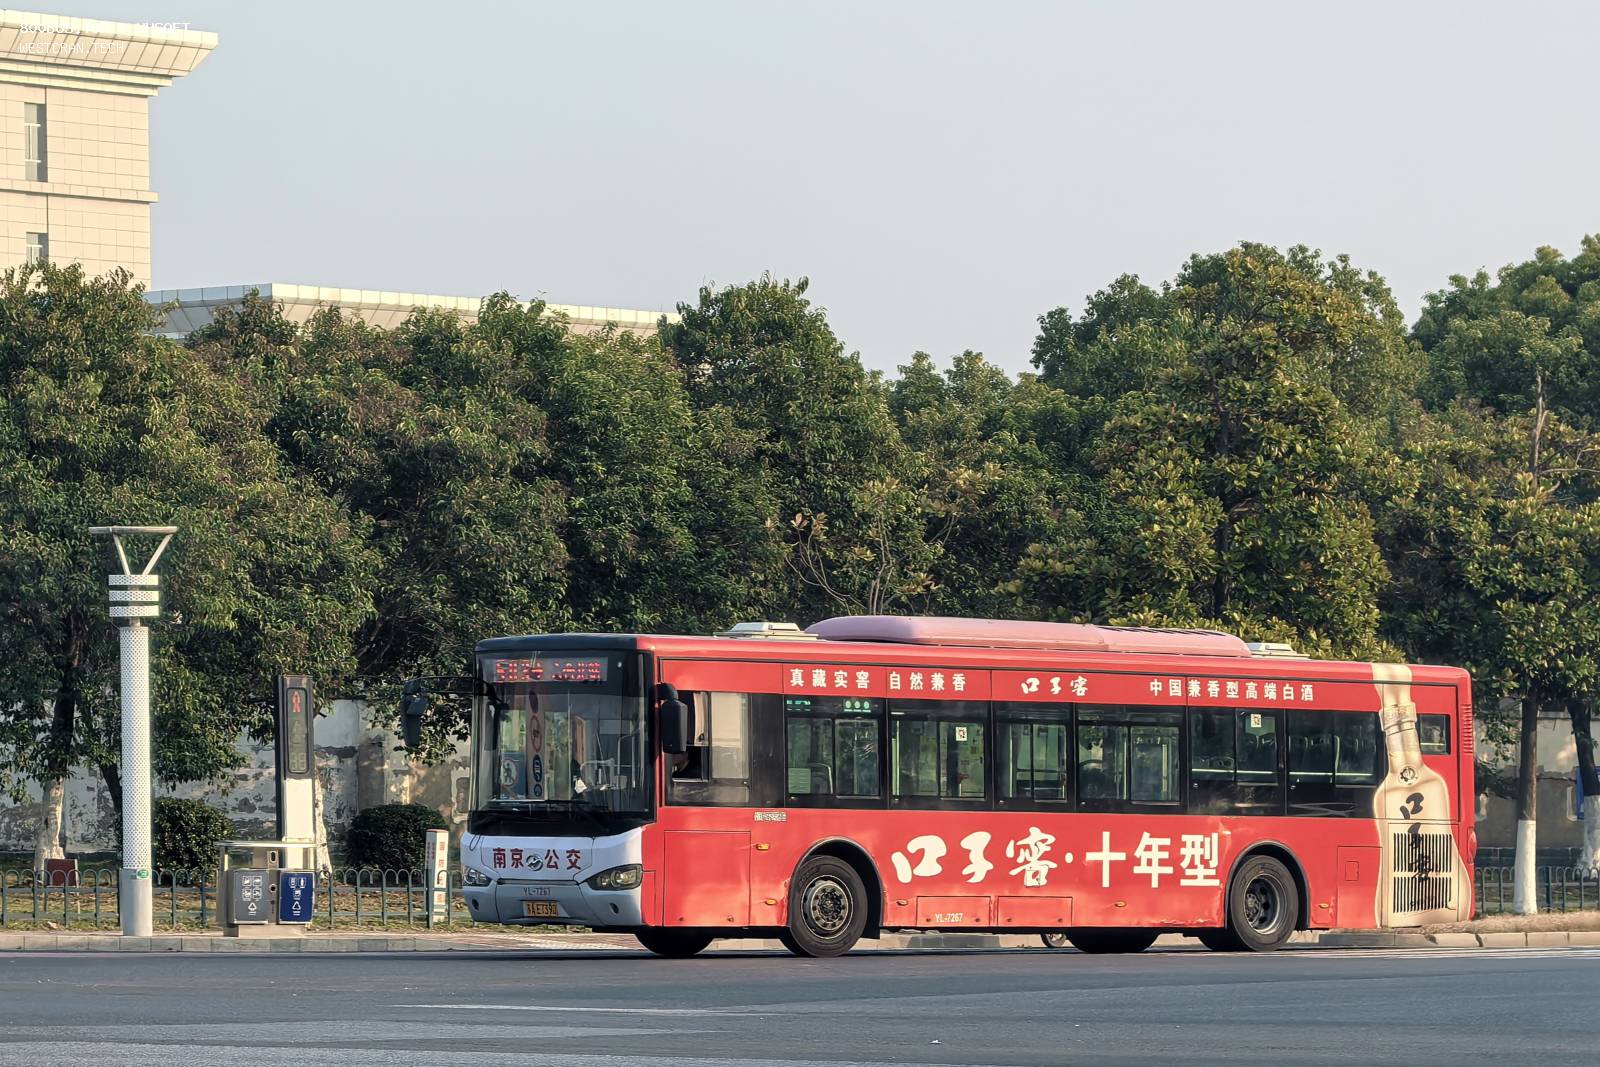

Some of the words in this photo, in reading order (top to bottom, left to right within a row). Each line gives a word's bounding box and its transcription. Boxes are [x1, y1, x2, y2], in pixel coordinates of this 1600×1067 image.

[790, 668, 870, 690] 真藏实窖
[889, 671, 966, 692] 自然兼香
[1149, 678, 1314, 702] 中国兼香型高端白酒
[492, 848, 524, 869] 南京
[544, 849, 582, 870] 公交
[935, 912, 964, 923] YL-7267
